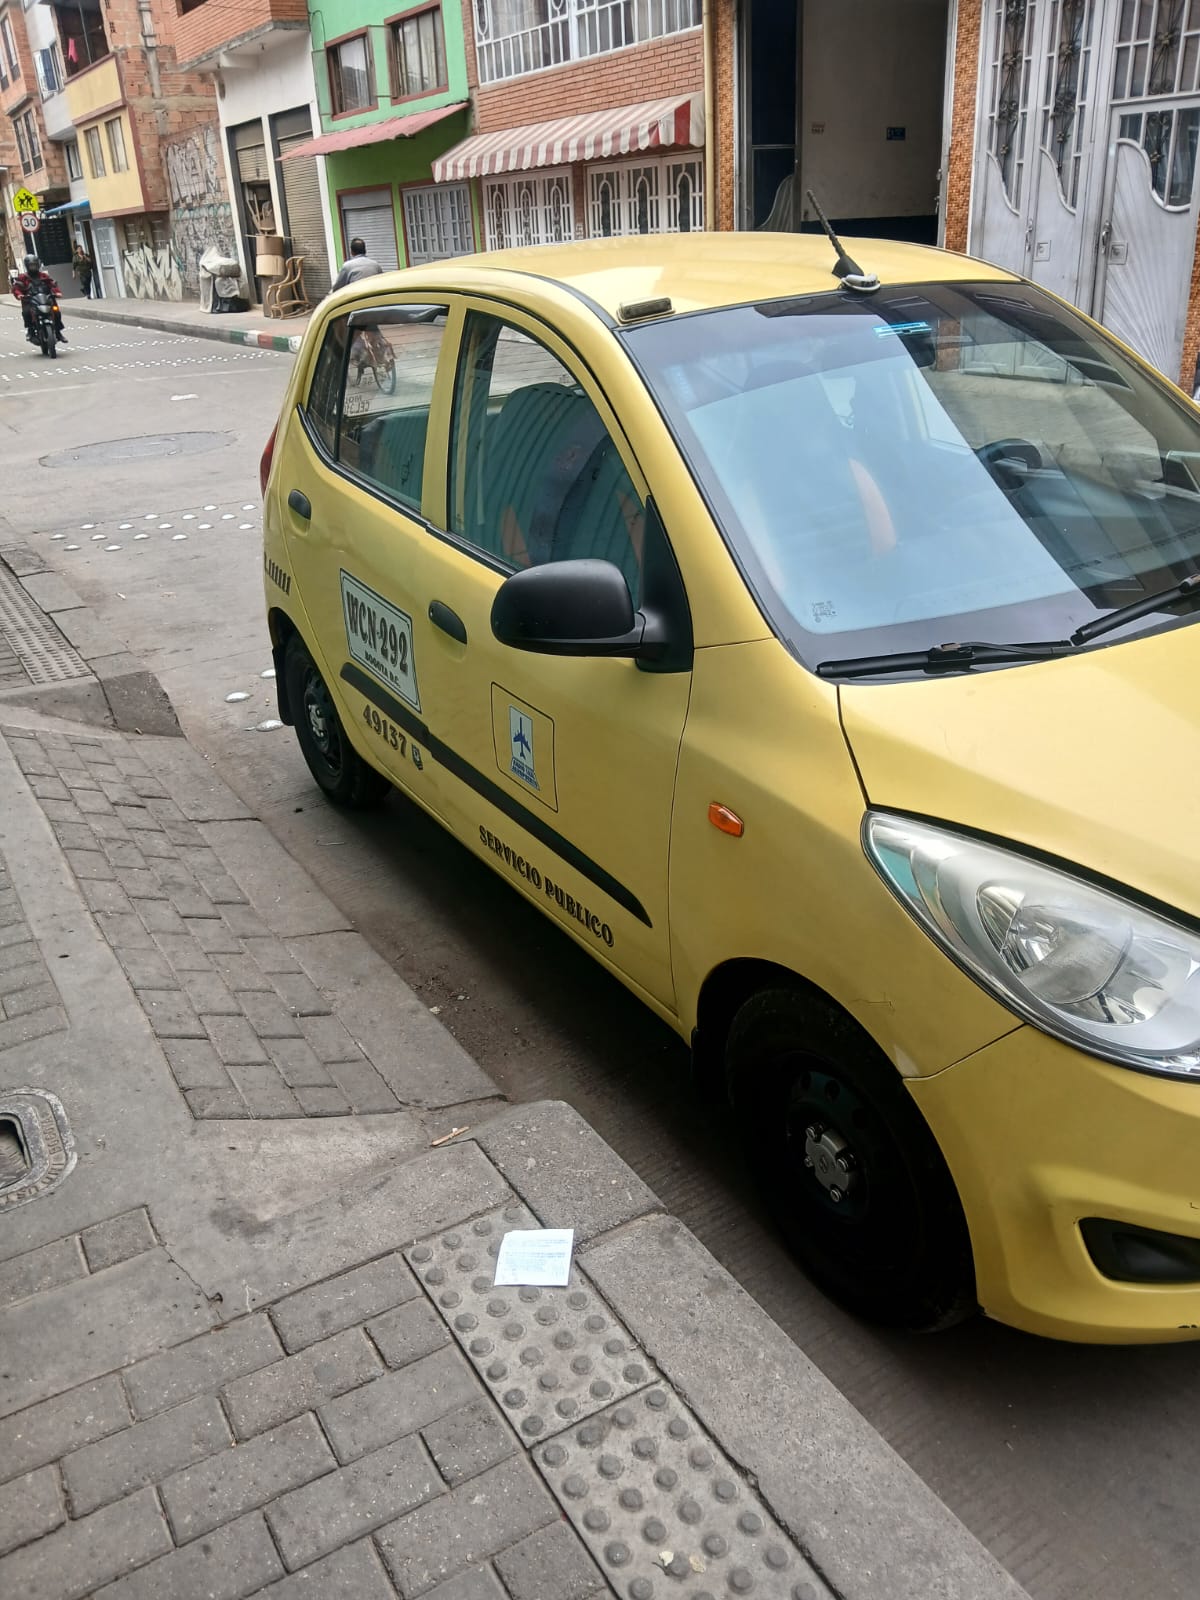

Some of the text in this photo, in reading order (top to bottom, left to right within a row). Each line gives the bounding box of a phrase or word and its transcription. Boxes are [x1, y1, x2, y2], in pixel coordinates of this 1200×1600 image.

[23, 218, 37, 227] 30
[363, 704, 407, 759] 49137
[479, 824, 615, 948] SERVICIO PUBLICO
